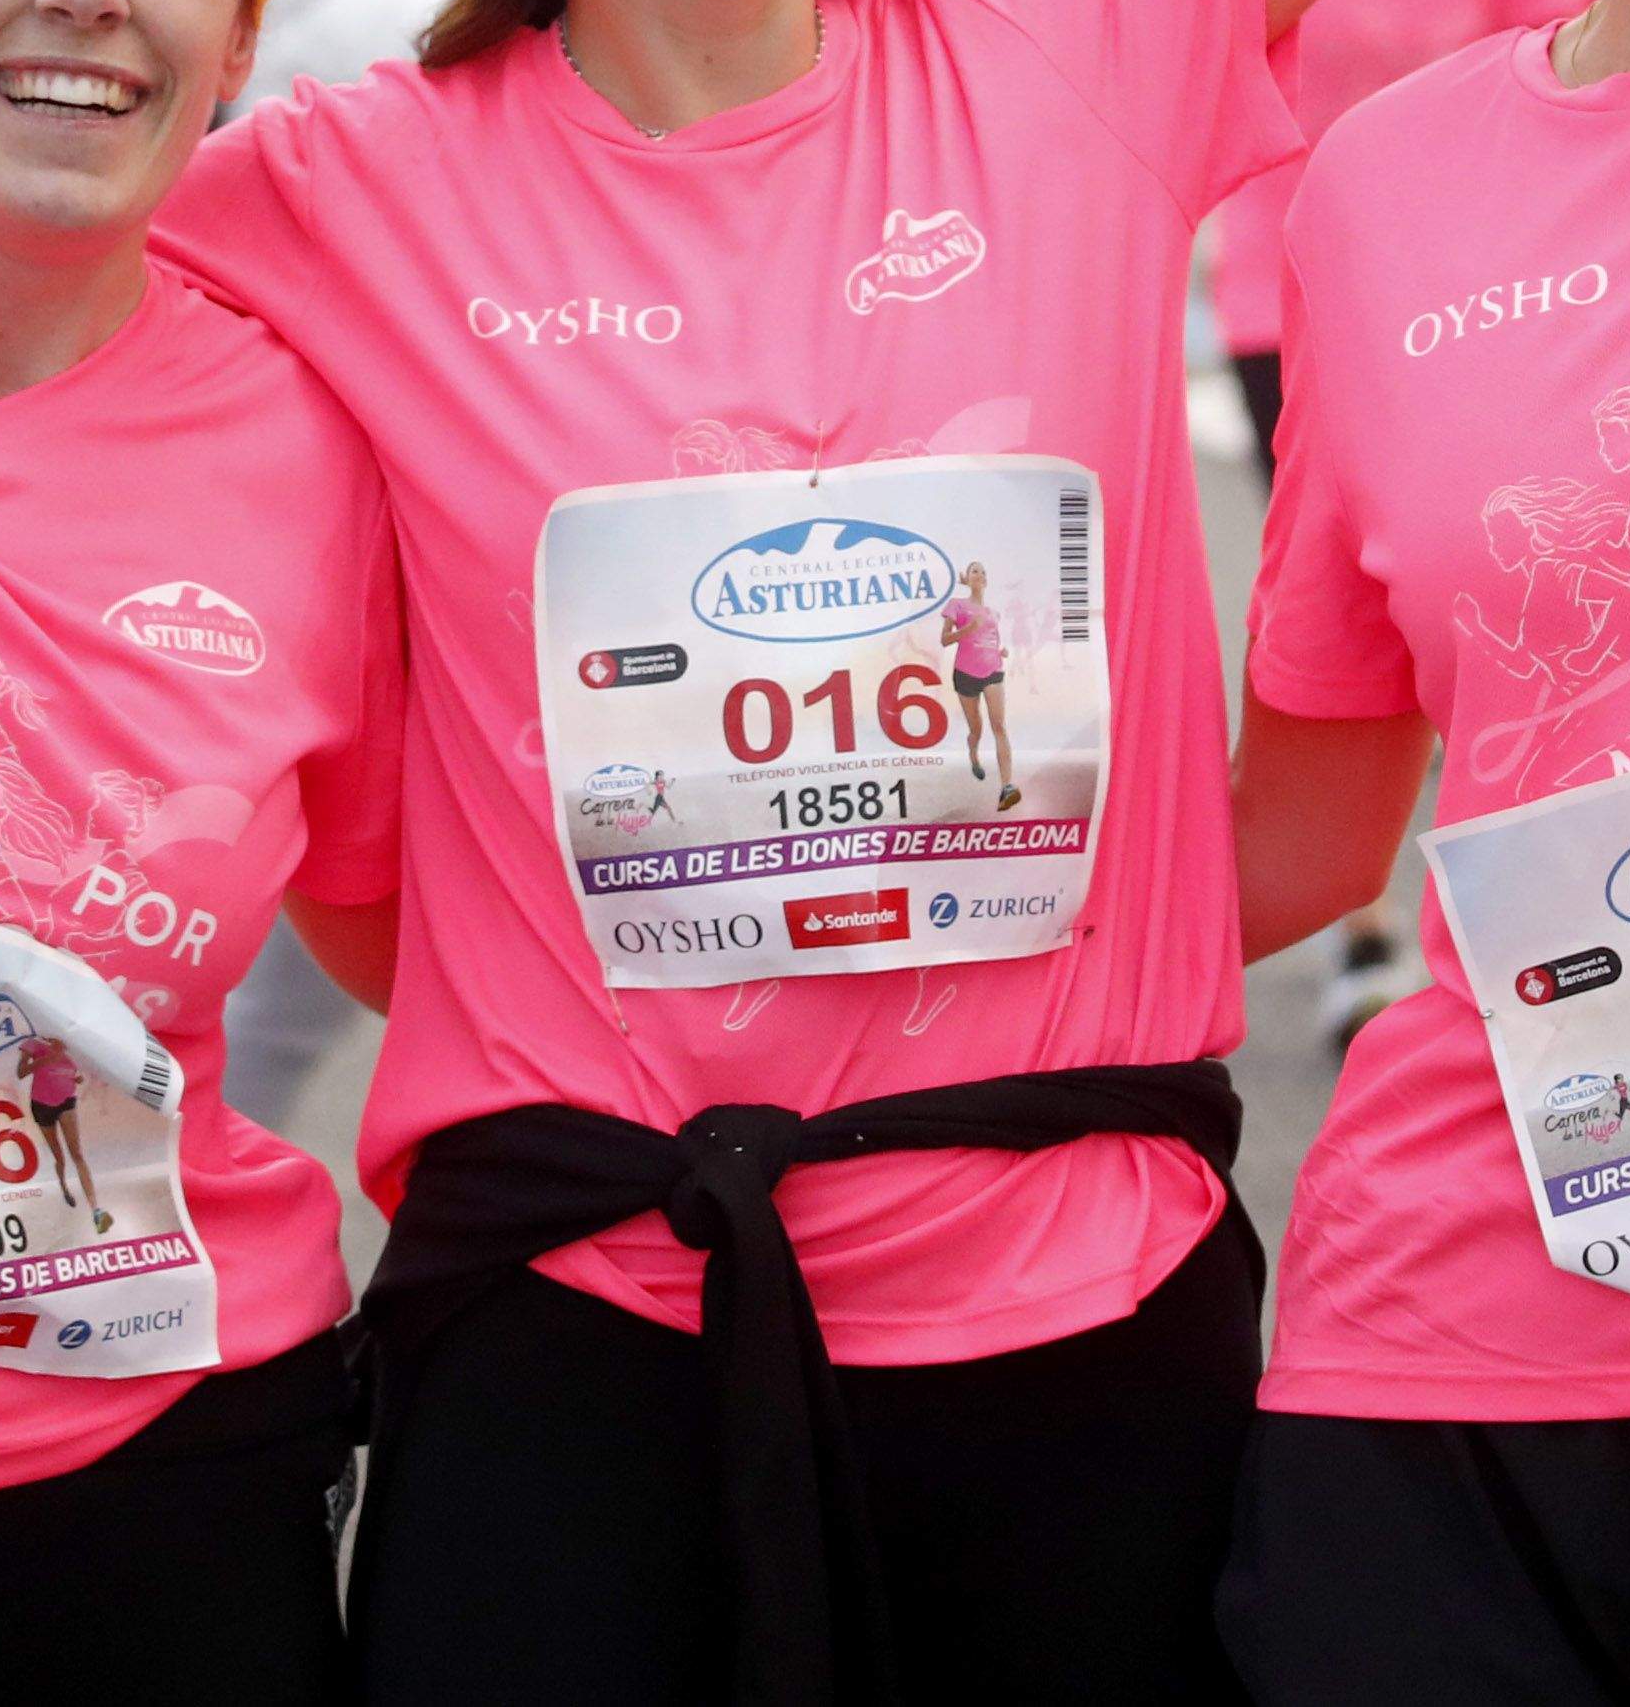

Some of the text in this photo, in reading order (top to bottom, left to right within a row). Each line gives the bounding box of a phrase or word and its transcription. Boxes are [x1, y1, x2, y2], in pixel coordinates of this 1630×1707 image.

[466, 296, 683, 346] OYSHO
[1402, 263, 1608, 358] OYSHO
[749, 551, 928, 578] CENTRAL LECHERA
[712, 569, 937, 618] ASTURIANA
[623, 661, 677, 677] Barcelona
[723, 663, 948, 764] 016
[728, 754, 945, 784] TELÉFONO VIOLENCIA DE GÉNERO
[769, 779, 907, 830] 18581
[592, 824, 1081, 888] CURSA DE LES DONES DE BARCELONA
[72, 864, 217, 966] POR
[823, 908, 898, 929] Santander
[970, 895, 1056, 918] ZURICH
[614, 913, 764, 954] OYSHO
[1558, 964, 1612, 988] Barcelona
[1545, 1106, 1601, 1132] Carrera
[22, 1262, 54, 1289] DE
[55, 1237, 192, 1283] BARCELONA
[102, 1308, 183, 1342] ZURICH
